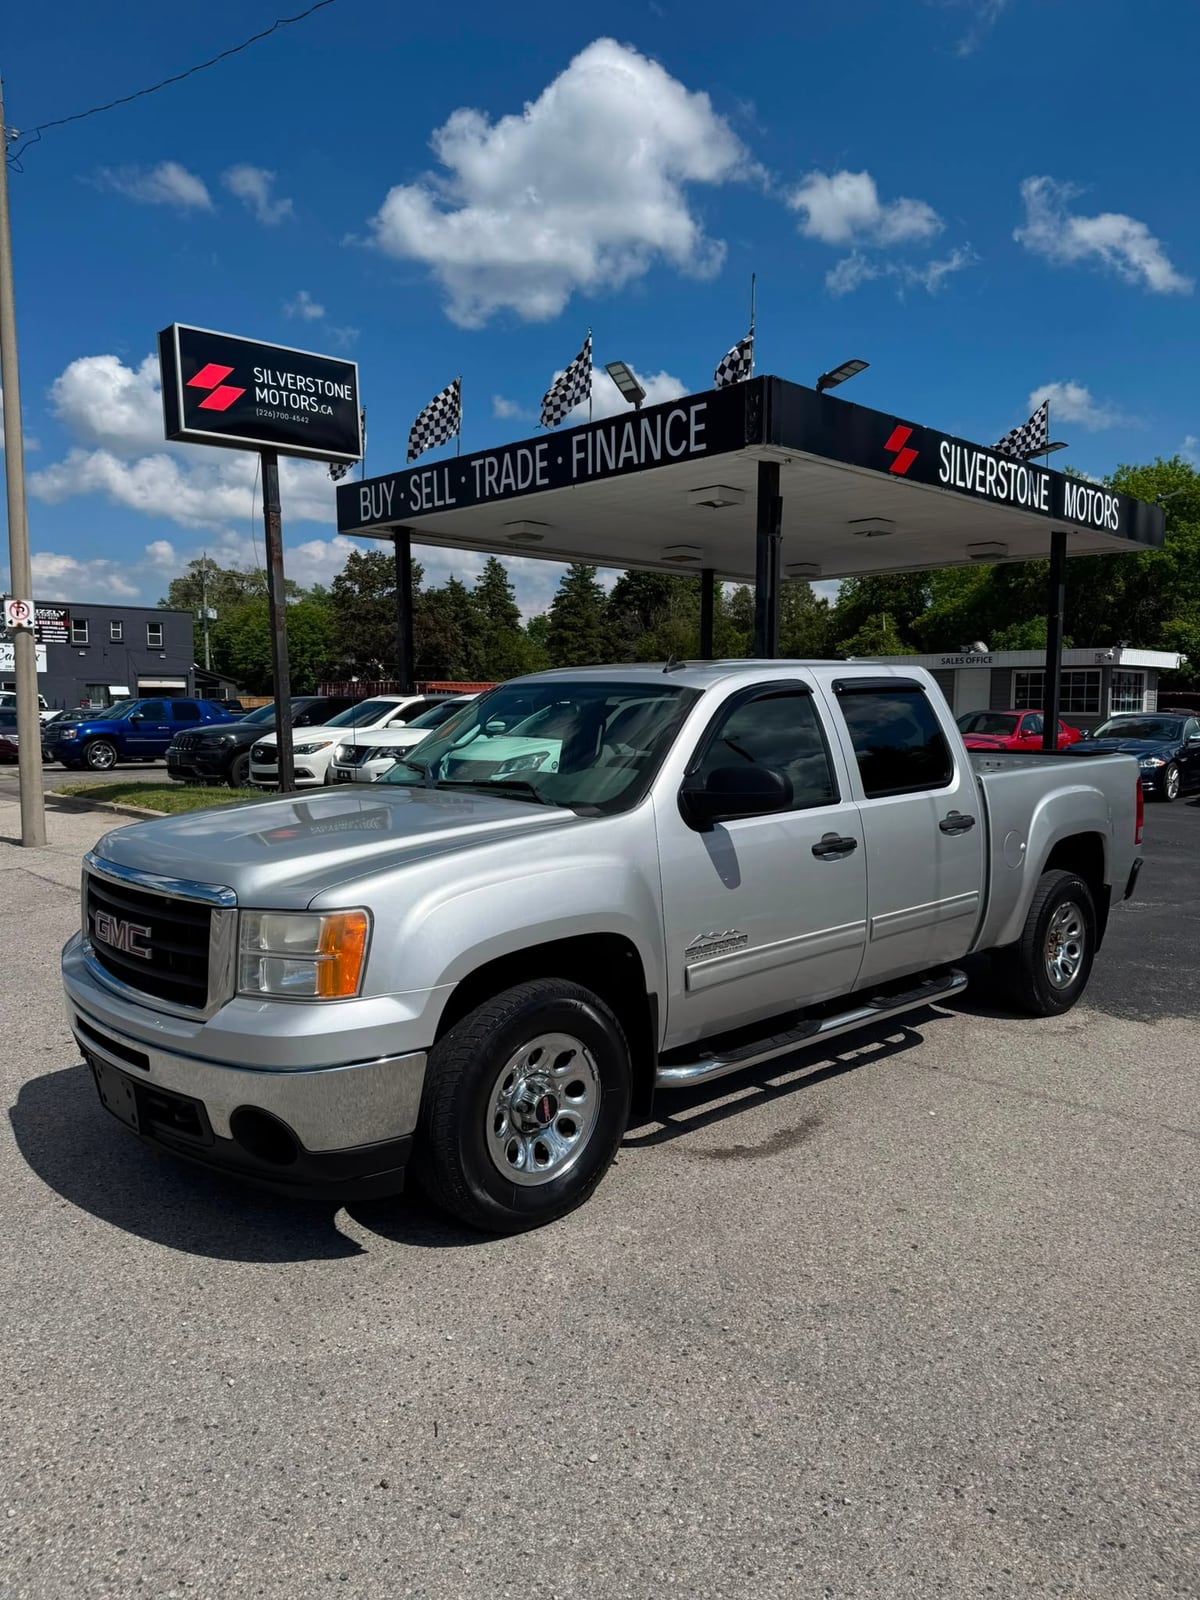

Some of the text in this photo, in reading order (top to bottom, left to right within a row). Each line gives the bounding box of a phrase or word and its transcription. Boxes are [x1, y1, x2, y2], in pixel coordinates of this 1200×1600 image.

[253, 367, 353, 400] SILVERSTONE
[255, 386, 334, 416] MOTORS.CA
[255, 408, 310, 424] (226)700-4542
[359, 402, 708, 522] BUY SELL TRADE FINANCE
[938, 440, 1120, 531] SILVERSTONE MOTORS
[941, 657, 964, 665] SALES
[95, 910, 152, 958] GMC
